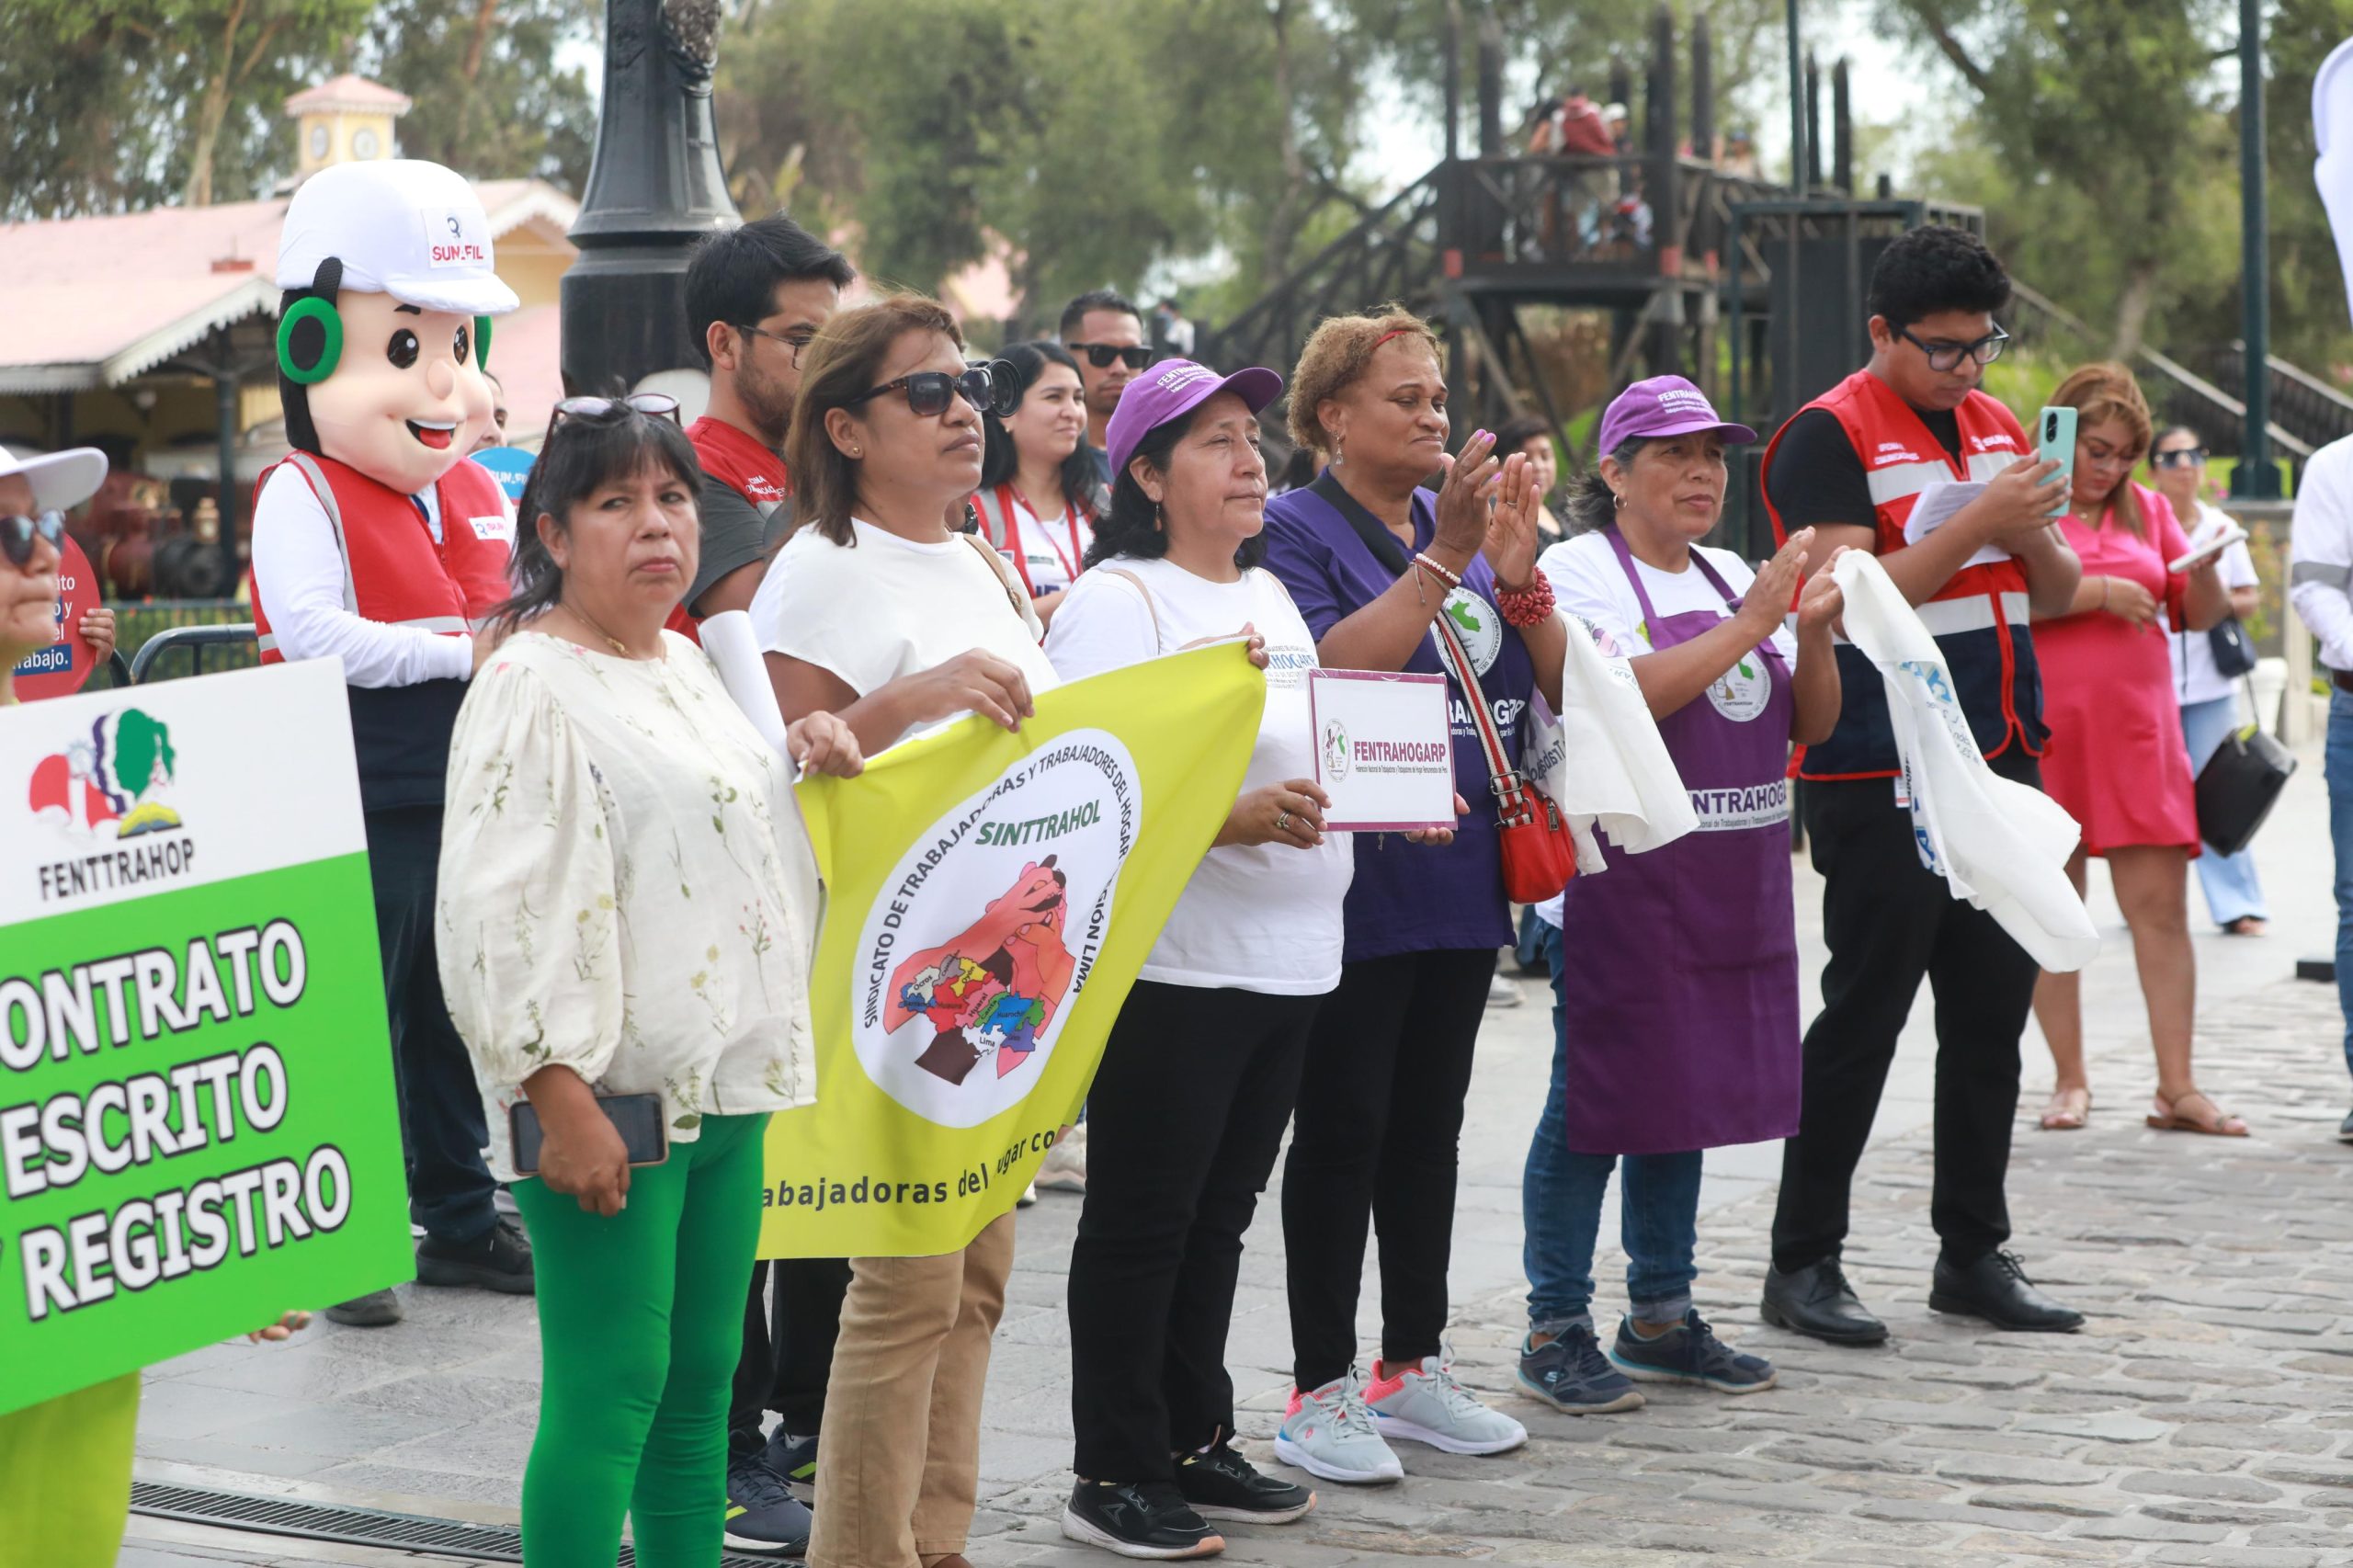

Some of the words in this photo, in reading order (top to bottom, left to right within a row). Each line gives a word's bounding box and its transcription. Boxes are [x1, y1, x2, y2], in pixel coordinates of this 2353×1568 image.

[64, 601, 73, 619] y
[13, 647, 69, 671] rabajo.
[1039, 744, 1118, 780] TRABAJADORES
[1354, 741, 1447, 762] FENTRAHOGARP
[1028, 762, 1038, 780] Y
[1112, 770, 1128, 803] DEL
[1691, 782, 1786, 814] NTRAHOG
[897, 772, 1026, 898] TRABAJADORAS
[974, 799, 1101, 846] SINTTRAHOL
[1119, 797, 1131, 858] HOGAR
[39, 838, 195, 901] FENTTRAHOP
[883, 900, 909, 929] DE
[864, 932, 895, 1029] SINDICATO
[914, 974, 933, 991] Ocros
[1073, 944, 1097, 994] LIMA
[968, 993, 988, 1017] Huaral
[979, 1037, 995, 1047] Lima
[0, 1041, 290, 1199] ESCRITO
[958, 1162, 989, 1199] del
[18, 1144, 352, 1322] REGISTRO
